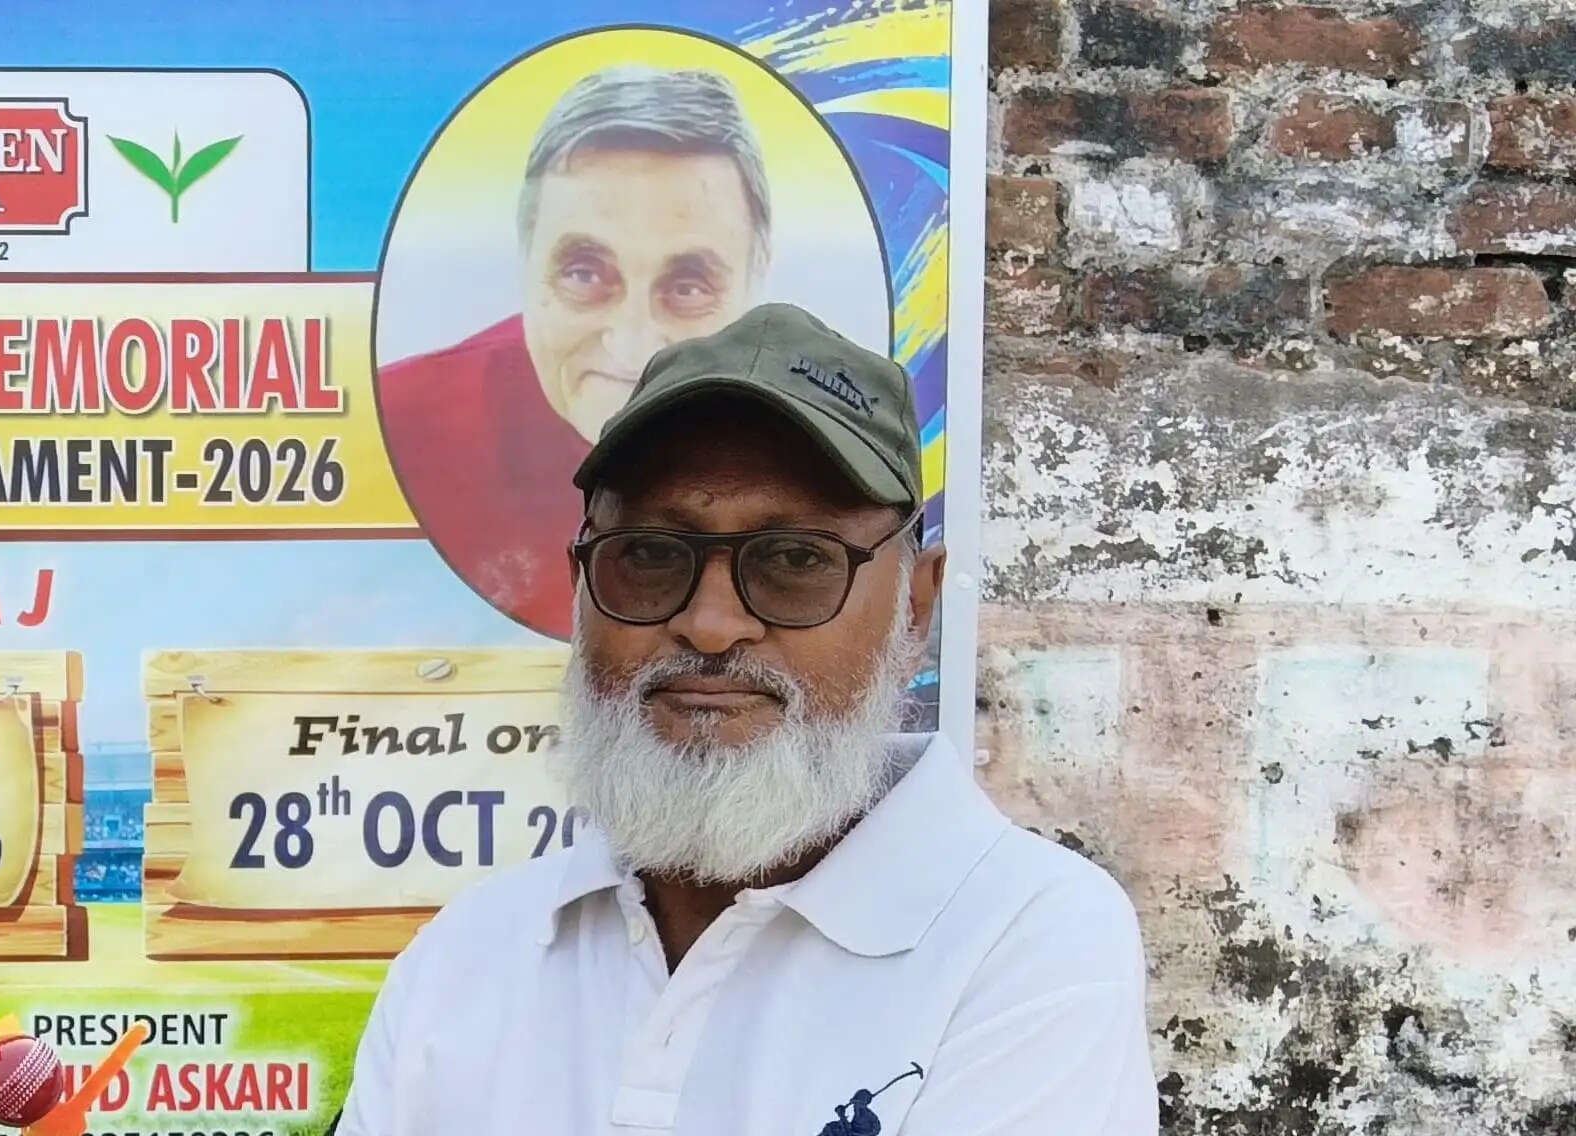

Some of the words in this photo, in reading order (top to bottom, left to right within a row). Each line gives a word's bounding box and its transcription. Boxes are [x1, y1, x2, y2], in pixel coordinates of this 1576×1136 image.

[288, 713, 465, 757] Final
[363, 790, 505, 868] OCT
[34, 1013, 228, 1046] PRESIDENT
[146, 1063, 309, 1111] ASKARI
